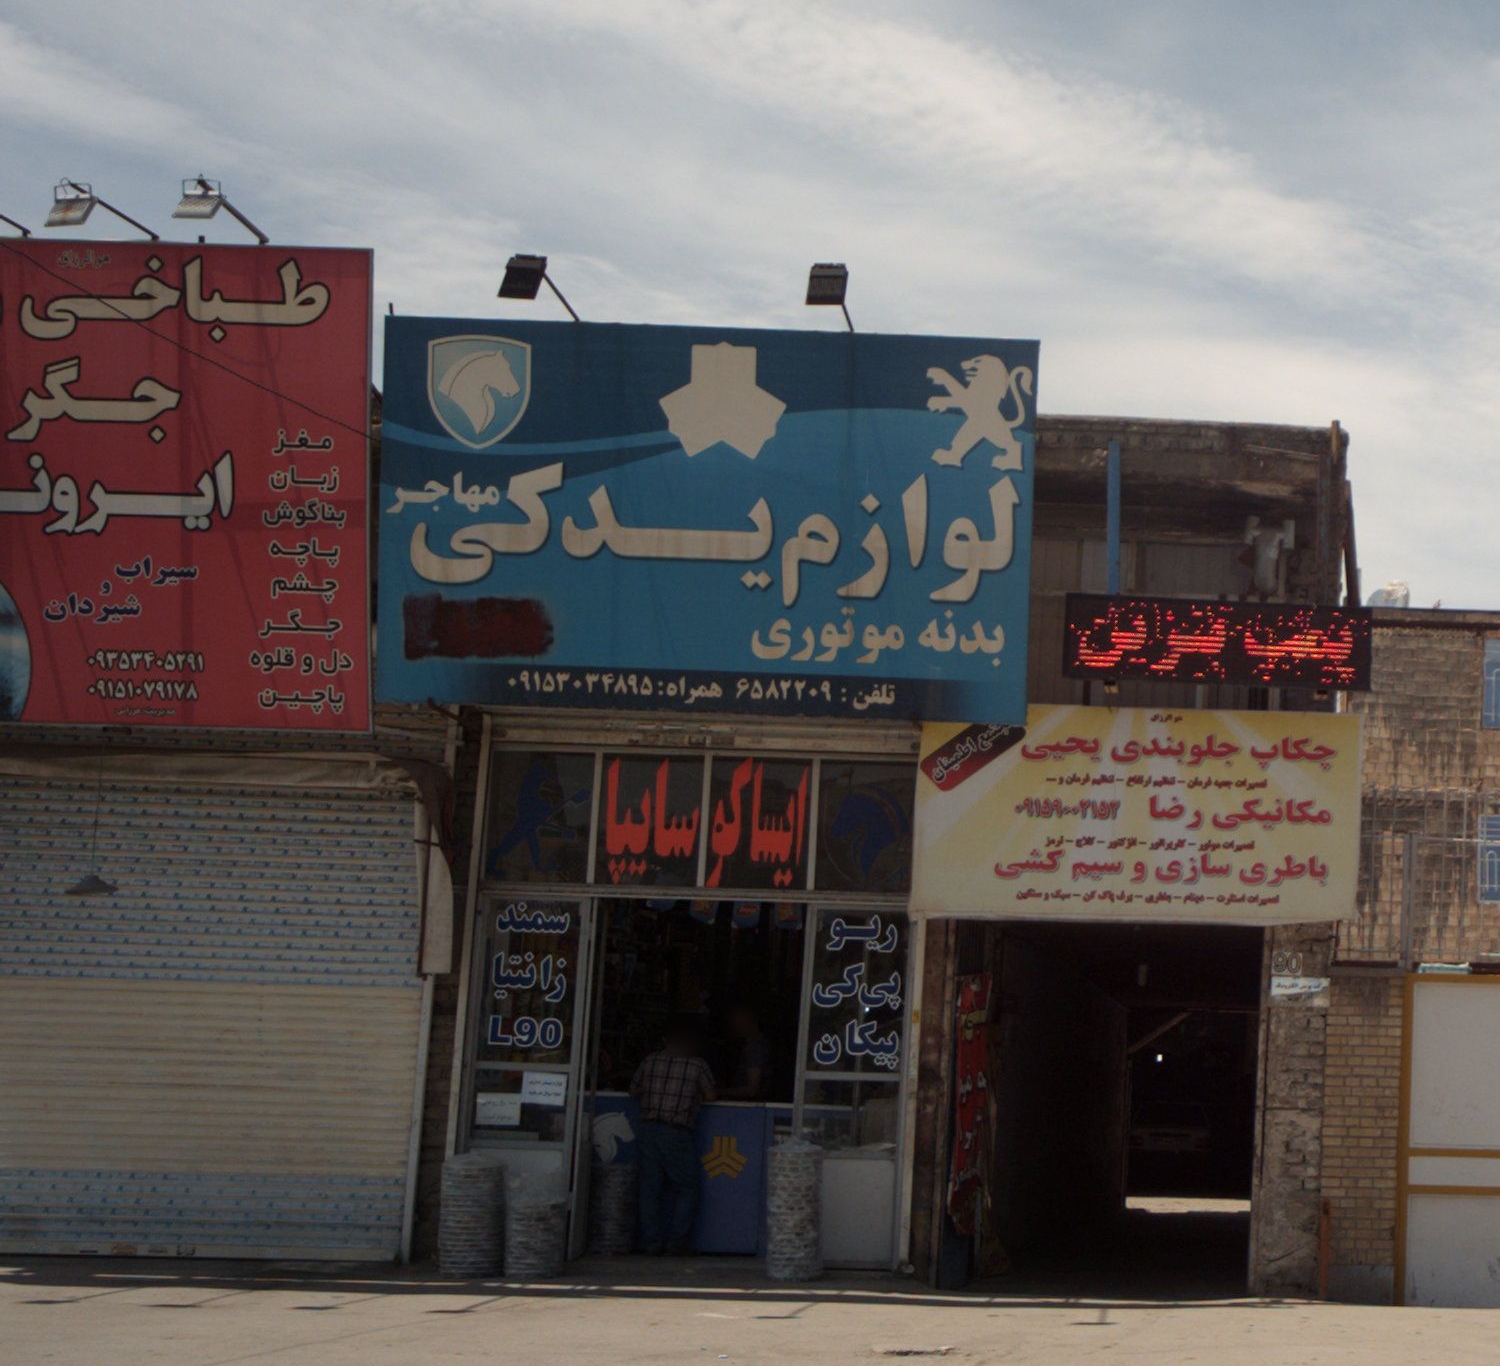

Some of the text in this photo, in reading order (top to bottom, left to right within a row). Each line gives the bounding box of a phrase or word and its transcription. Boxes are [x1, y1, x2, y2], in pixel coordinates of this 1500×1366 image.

[20, 254, 331, 343] طباخی
[5, 355, 182, 443] جگر
[273, 429, 333, 454] مغز
[0, 450, 235, 536] ایرون
[269, 464, 339, 491] زبان
[386, 471, 500, 514] مهاجر
[263, 499, 346, 528] بناگوش
[409, 461, 1022, 608] لوازم یدکی
[269, 538, 339, 566] پاچه
[272, 571, 338, 602] چشم
[260, 610, 343, 640] جگر
[751, 606, 1006, 666] بدنه موتوری
[249, 647, 354, 674] دل و قلوه
[87, 678, 200, 700] ۰۹۱۵۱۰۷۹۱۷۸
[508, 671, 654, 695] ۰۹۱۵۳۰۳۴۸۹۵
[736, 677, 832, 702] ۶۵۸۲۲۰۹
[852, 683, 896, 710] تلفن
[259, 685, 345, 714] پاچین
[1111, 734, 1241, 766] جلوبندی
[1250, 736, 1337, 771] چکاپ
[606, 756, 809, 887] ایساکو سایپا
[1149, 794, 1204, 830] رضا
[1212, 798, 1333, 830] مکانیکی
[994, 848, 1329, 887] باطری سازی و سیم کشی
[496, 902, 570, 934] سمند
[826, 914, 898, 953] ریو
[492, 951, 567, 1002] زانتیا
[488, 1015, 563, 1048] L90
[814, 1019, 899, 1069] پیکان
